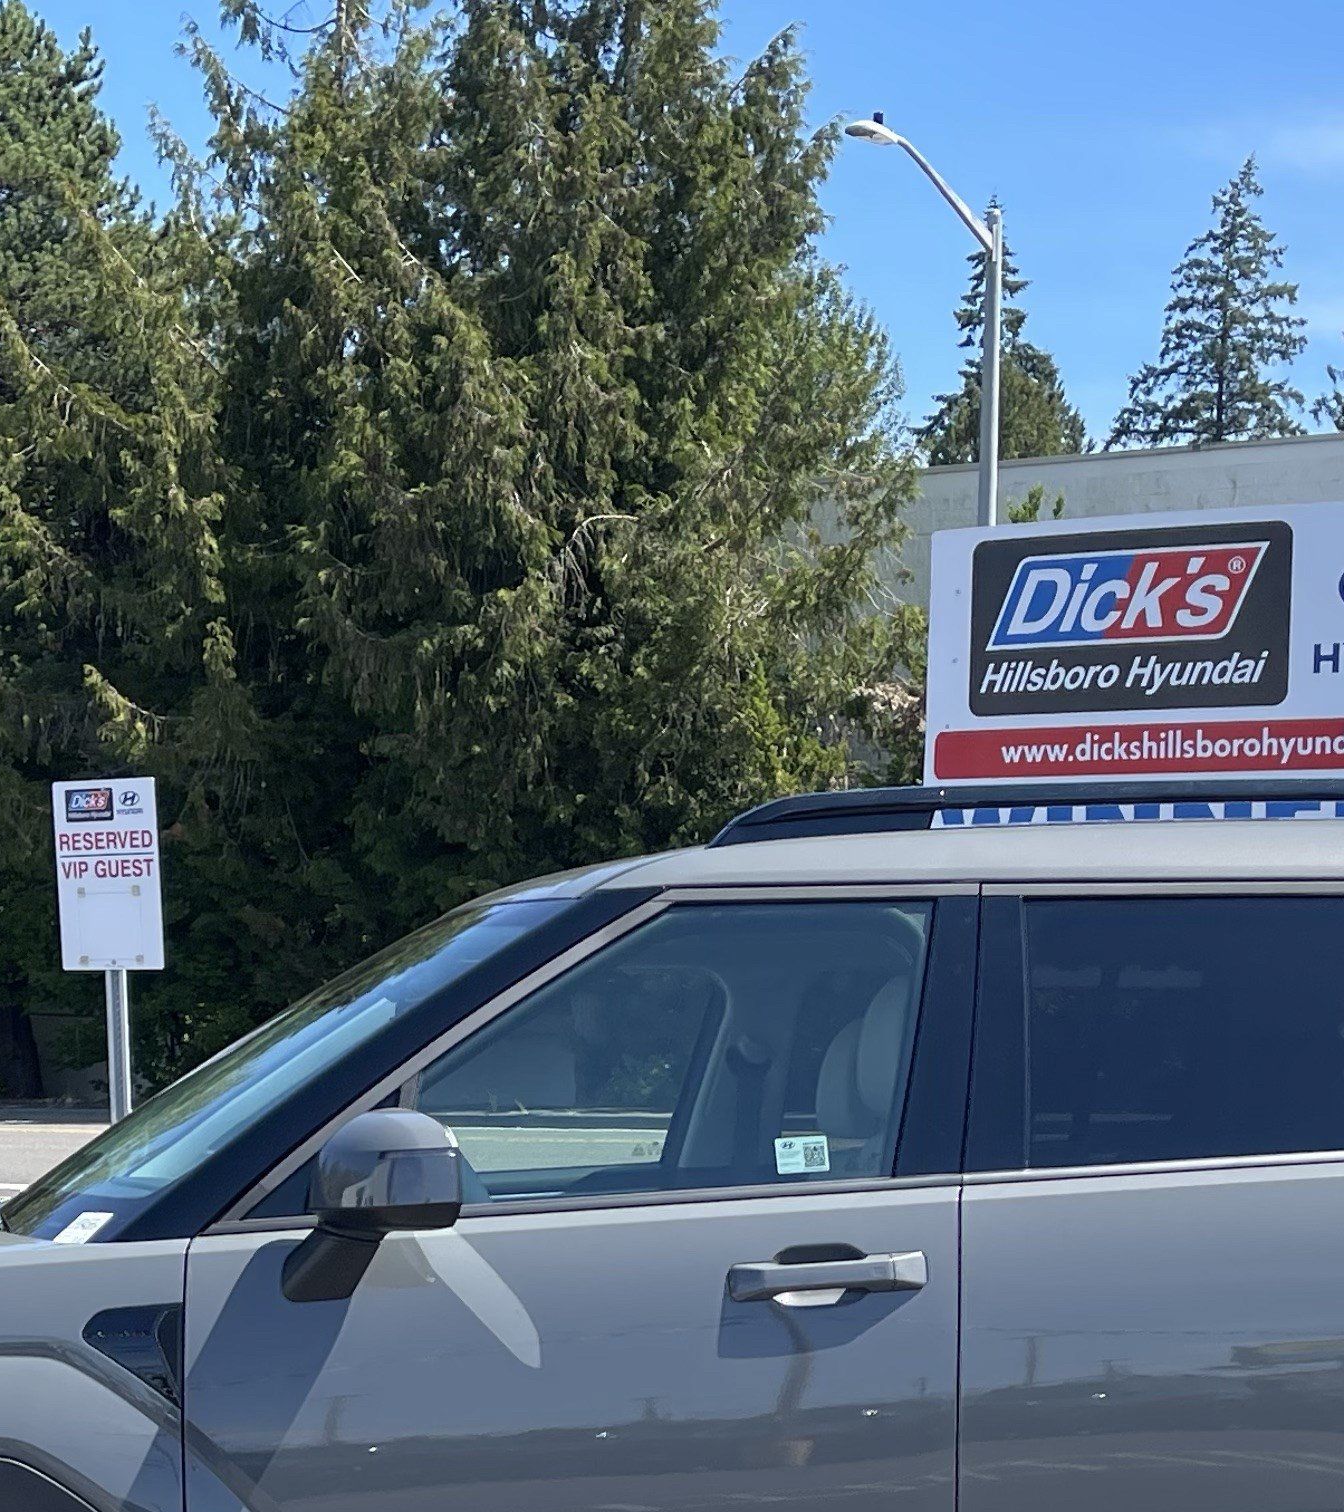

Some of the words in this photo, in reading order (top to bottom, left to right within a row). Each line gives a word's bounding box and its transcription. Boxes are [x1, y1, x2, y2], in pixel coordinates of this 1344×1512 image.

[1006, 556, 1231, 636] Dick's
[979, 658, 1120, 694] Hillsboro
[1124, 650, 1269, 696] Hyundai
[59, 830, 153, 851] RESERVED
[61, 860, 89, 880] VIP
[94, 858, 155, 879] GUEST
